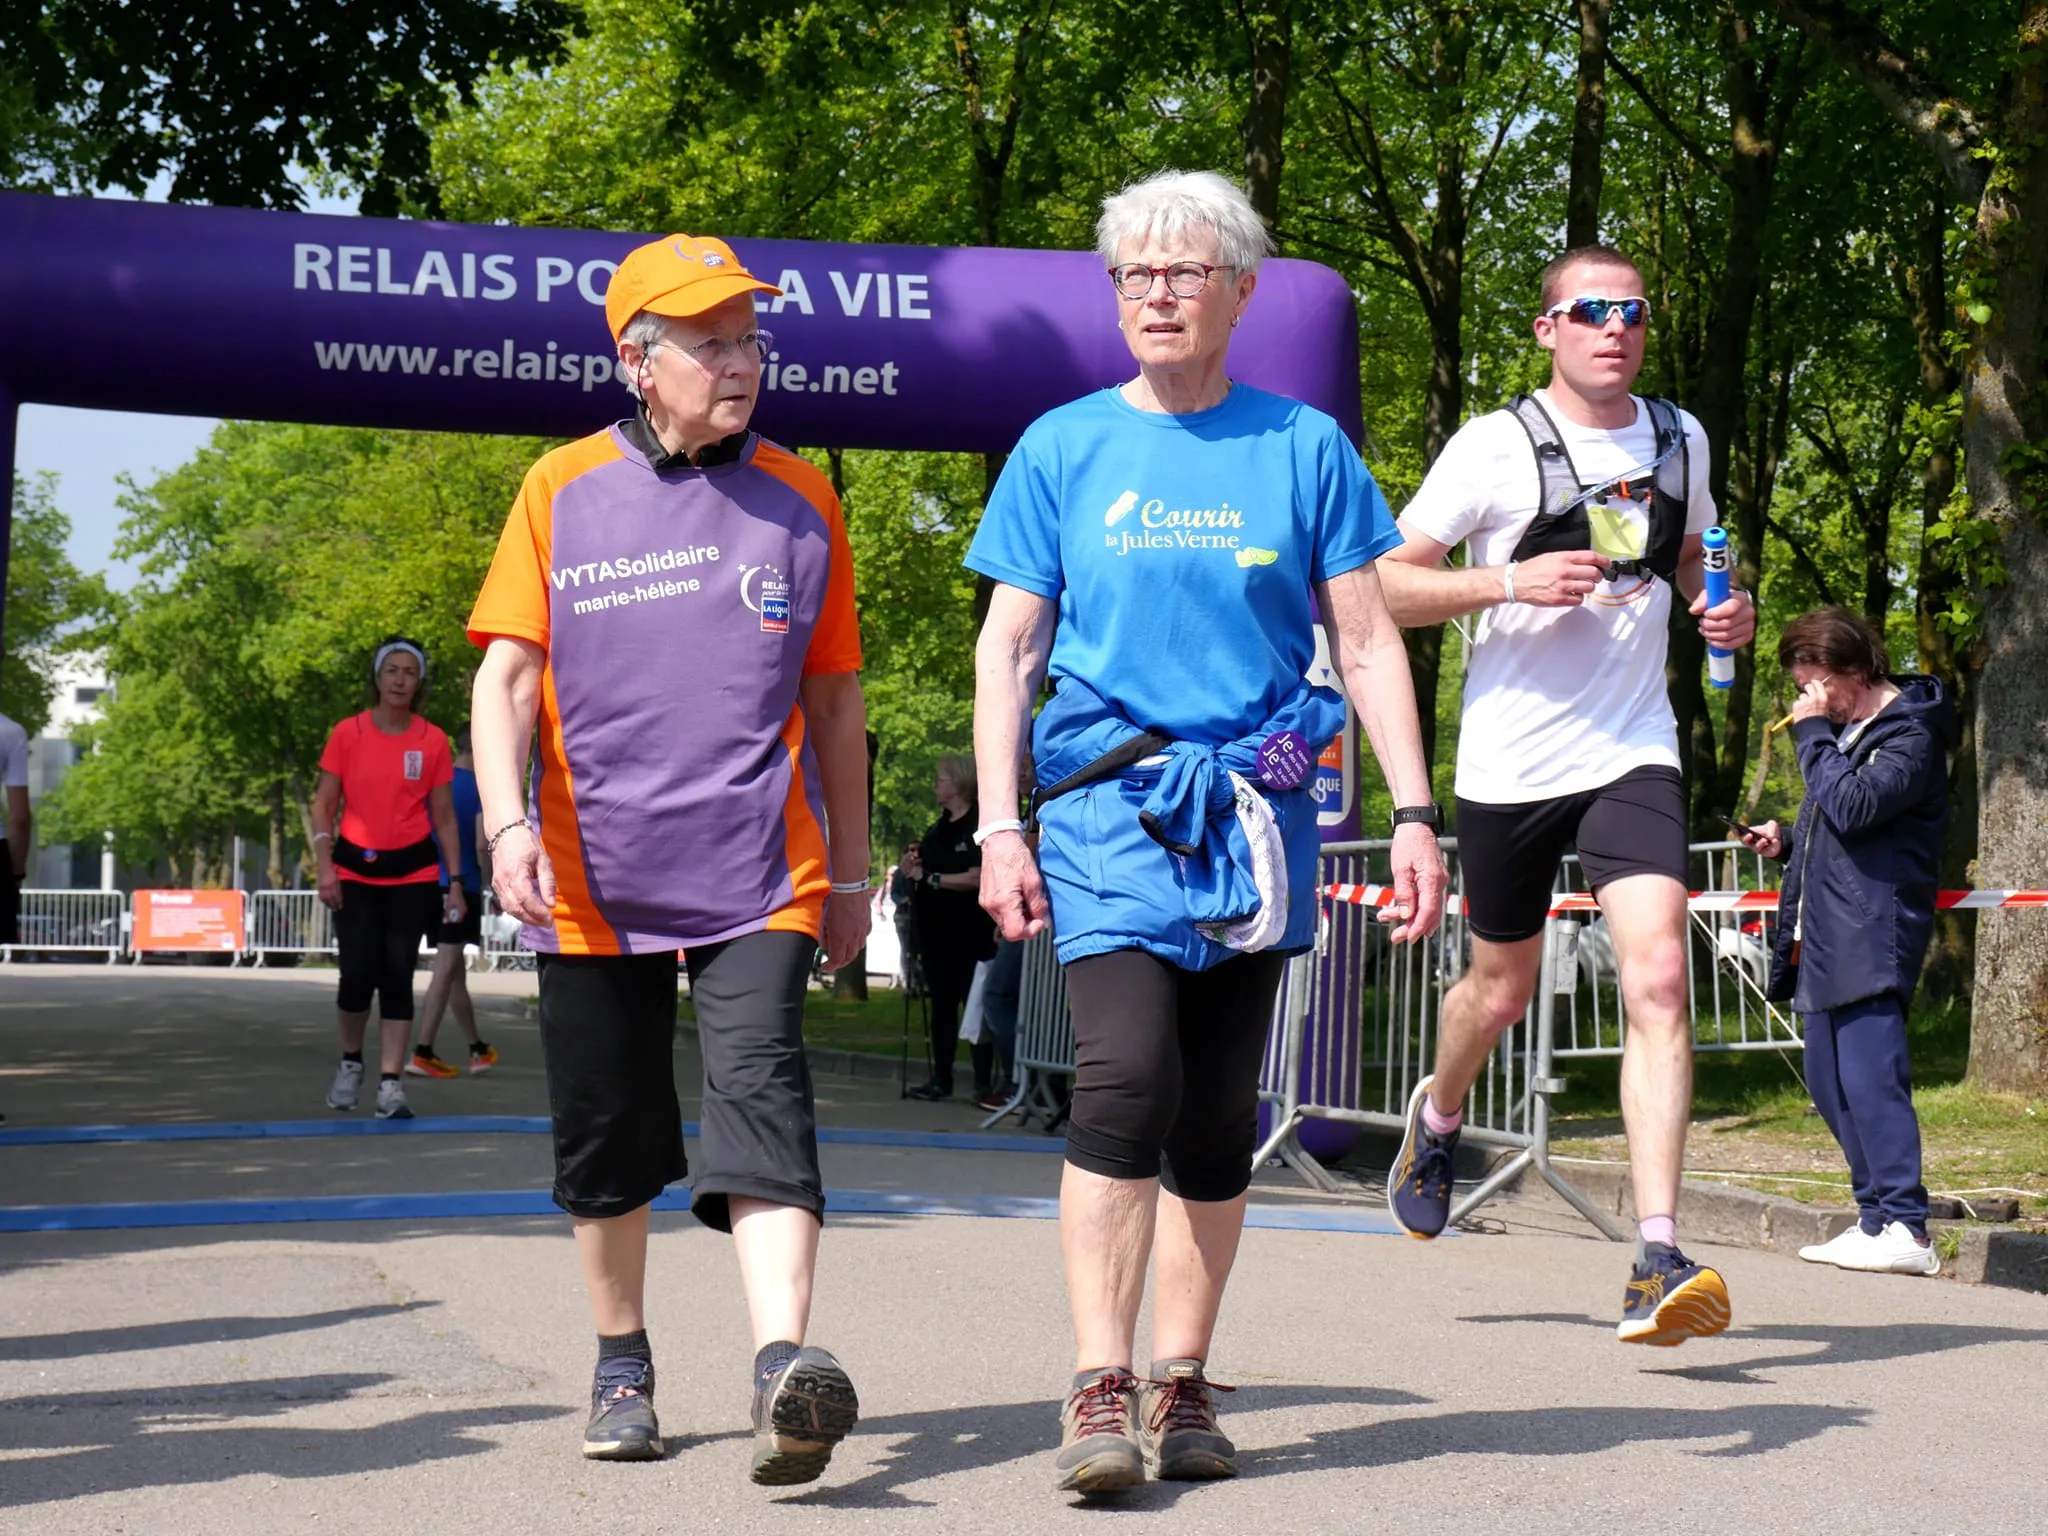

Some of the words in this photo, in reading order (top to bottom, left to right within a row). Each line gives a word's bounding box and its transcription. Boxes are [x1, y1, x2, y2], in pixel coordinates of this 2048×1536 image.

[294, 243, 518, 301] RELAIS
[536, 256, 612, 306] PO
[828, 271, 932, 319] VIE
[1141, 499, 1245, 529] Courir
[1105, 533, 1119, 547] la
[550, 545, 720, 591] VYTASolidaire
[574, 578, 701, 615] marie-hélène
[1263, 746, 1280, 766] Je
[1277, 733, 1294, 753] Je
